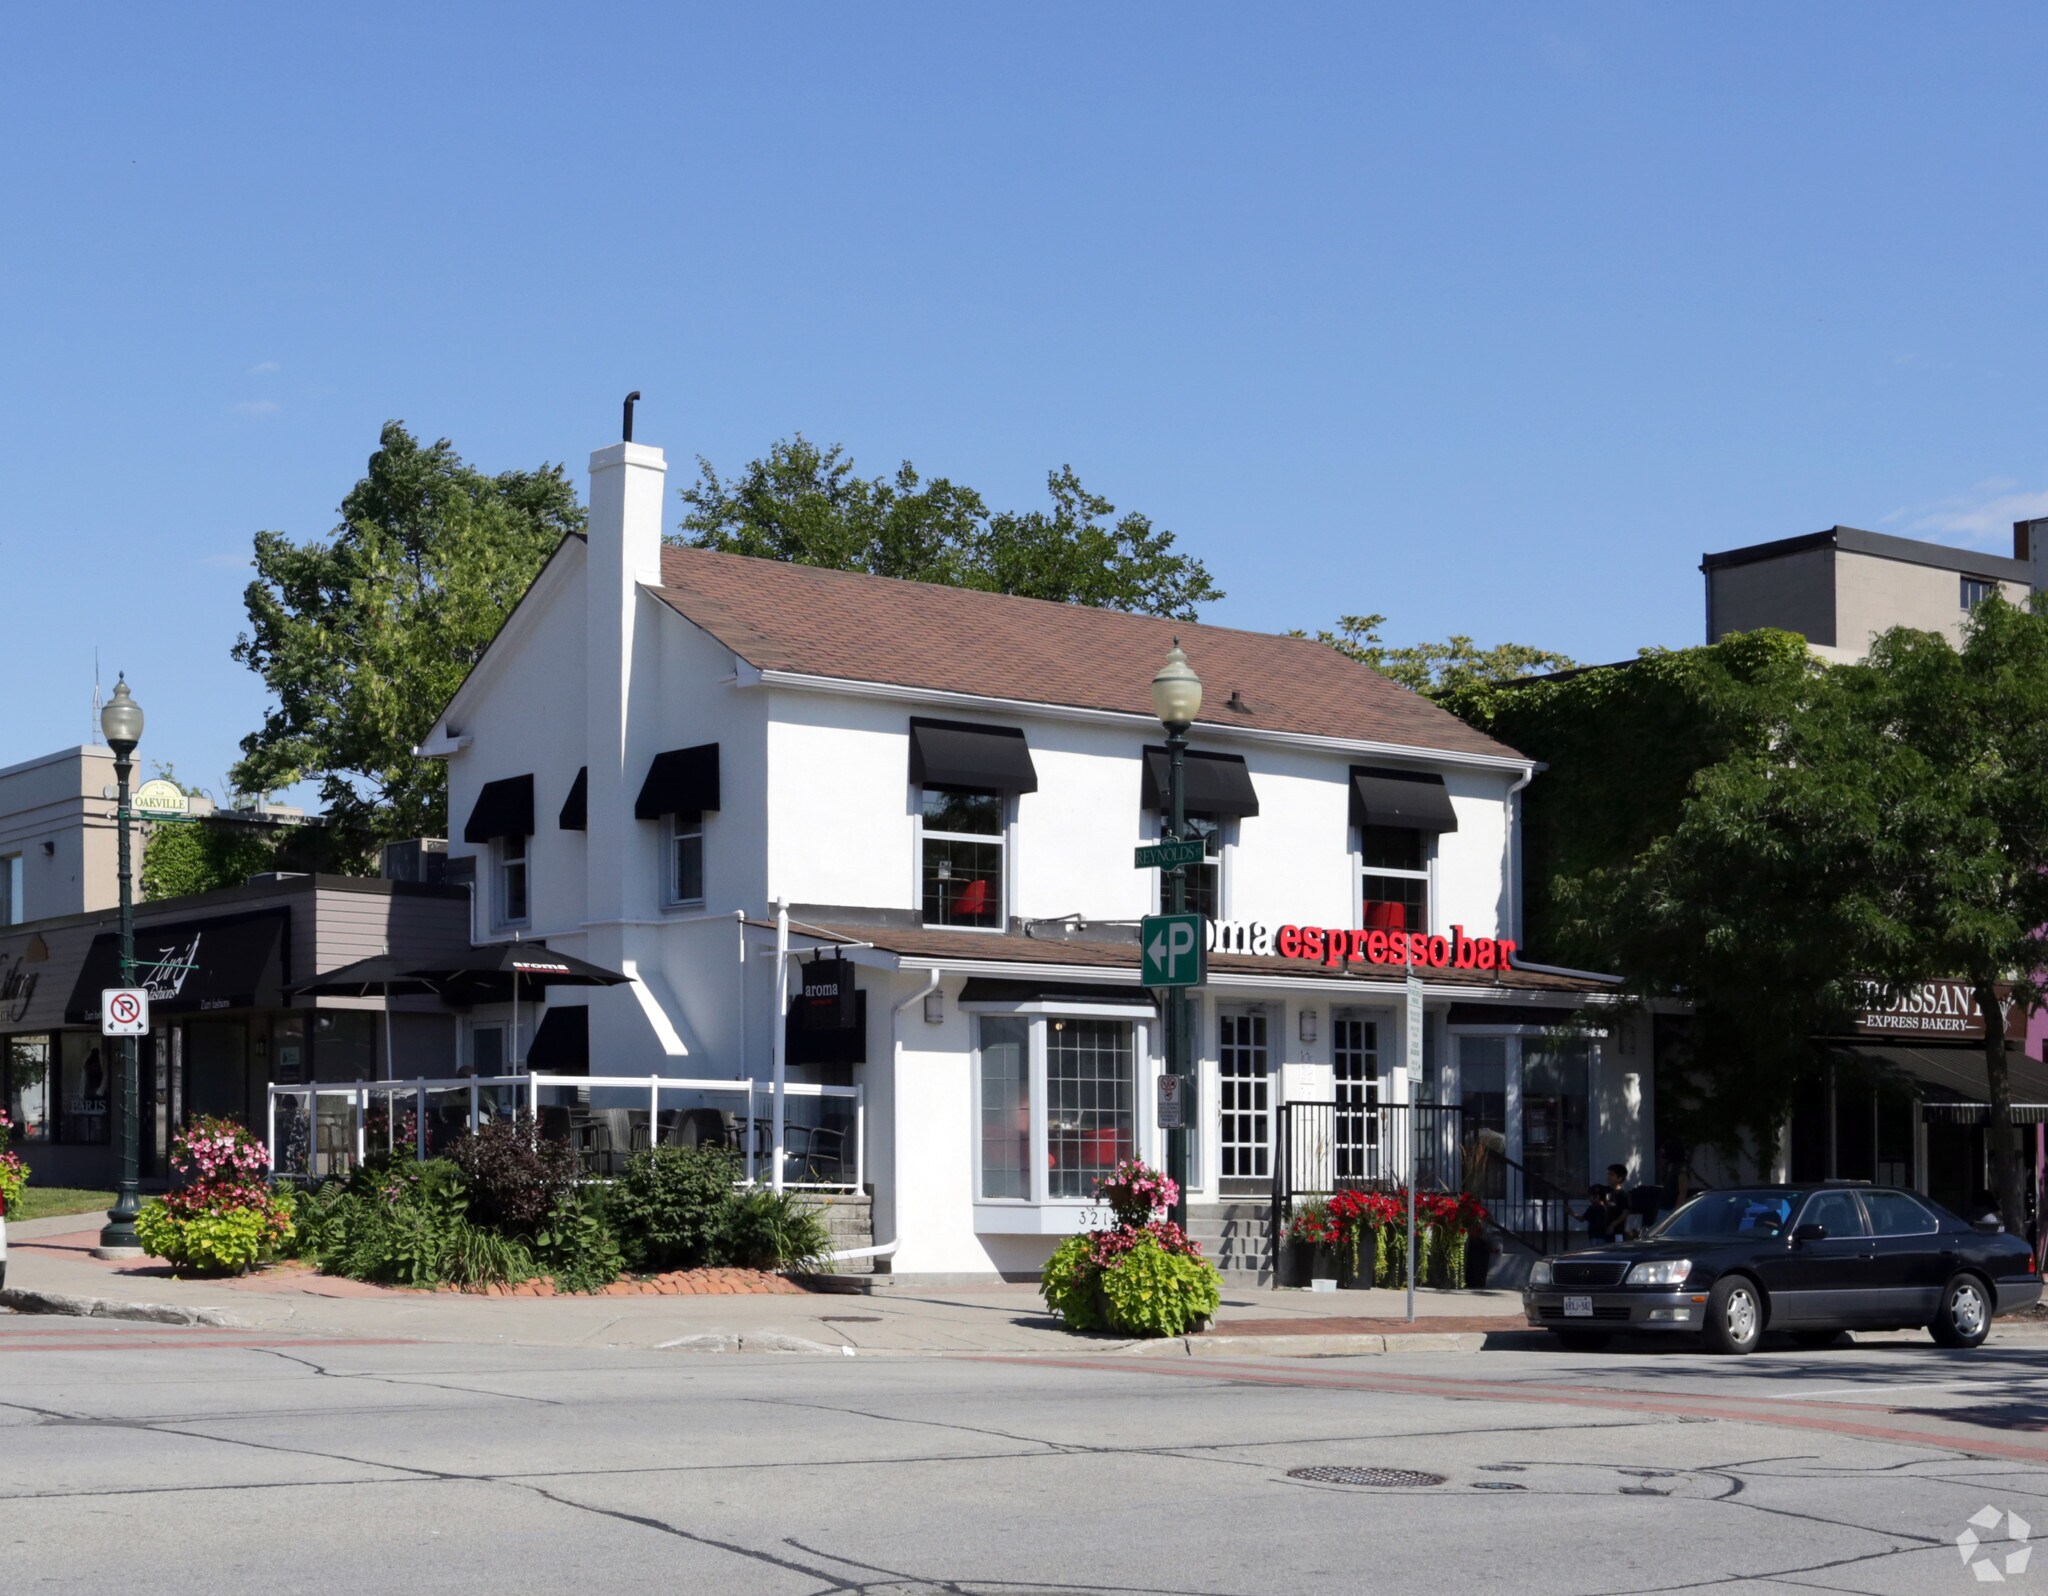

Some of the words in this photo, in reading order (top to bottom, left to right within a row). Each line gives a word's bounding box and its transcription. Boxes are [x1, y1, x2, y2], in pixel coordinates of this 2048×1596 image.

[135, 797, 185, 809] OAKVILLE
[1136, 845, 1194, 864] REYNOLDS
[1168, 922, 1194, 978] P
[1275, 925, 1449, 967] espresso
[1451, 925, 1516, 971] bar
[512, 961, 569, 970] aroma
[805, 983, 838, 997] aroma
[200, 998, 212, 1010] Zuri
[212, 997, 231, 1009] fashions
[1866, 1015, 1919, 1030] EXPRESS
[1921, 1017, 1967, 1031] BAKERY
[71, 1100, 107, 1112] PARIS
